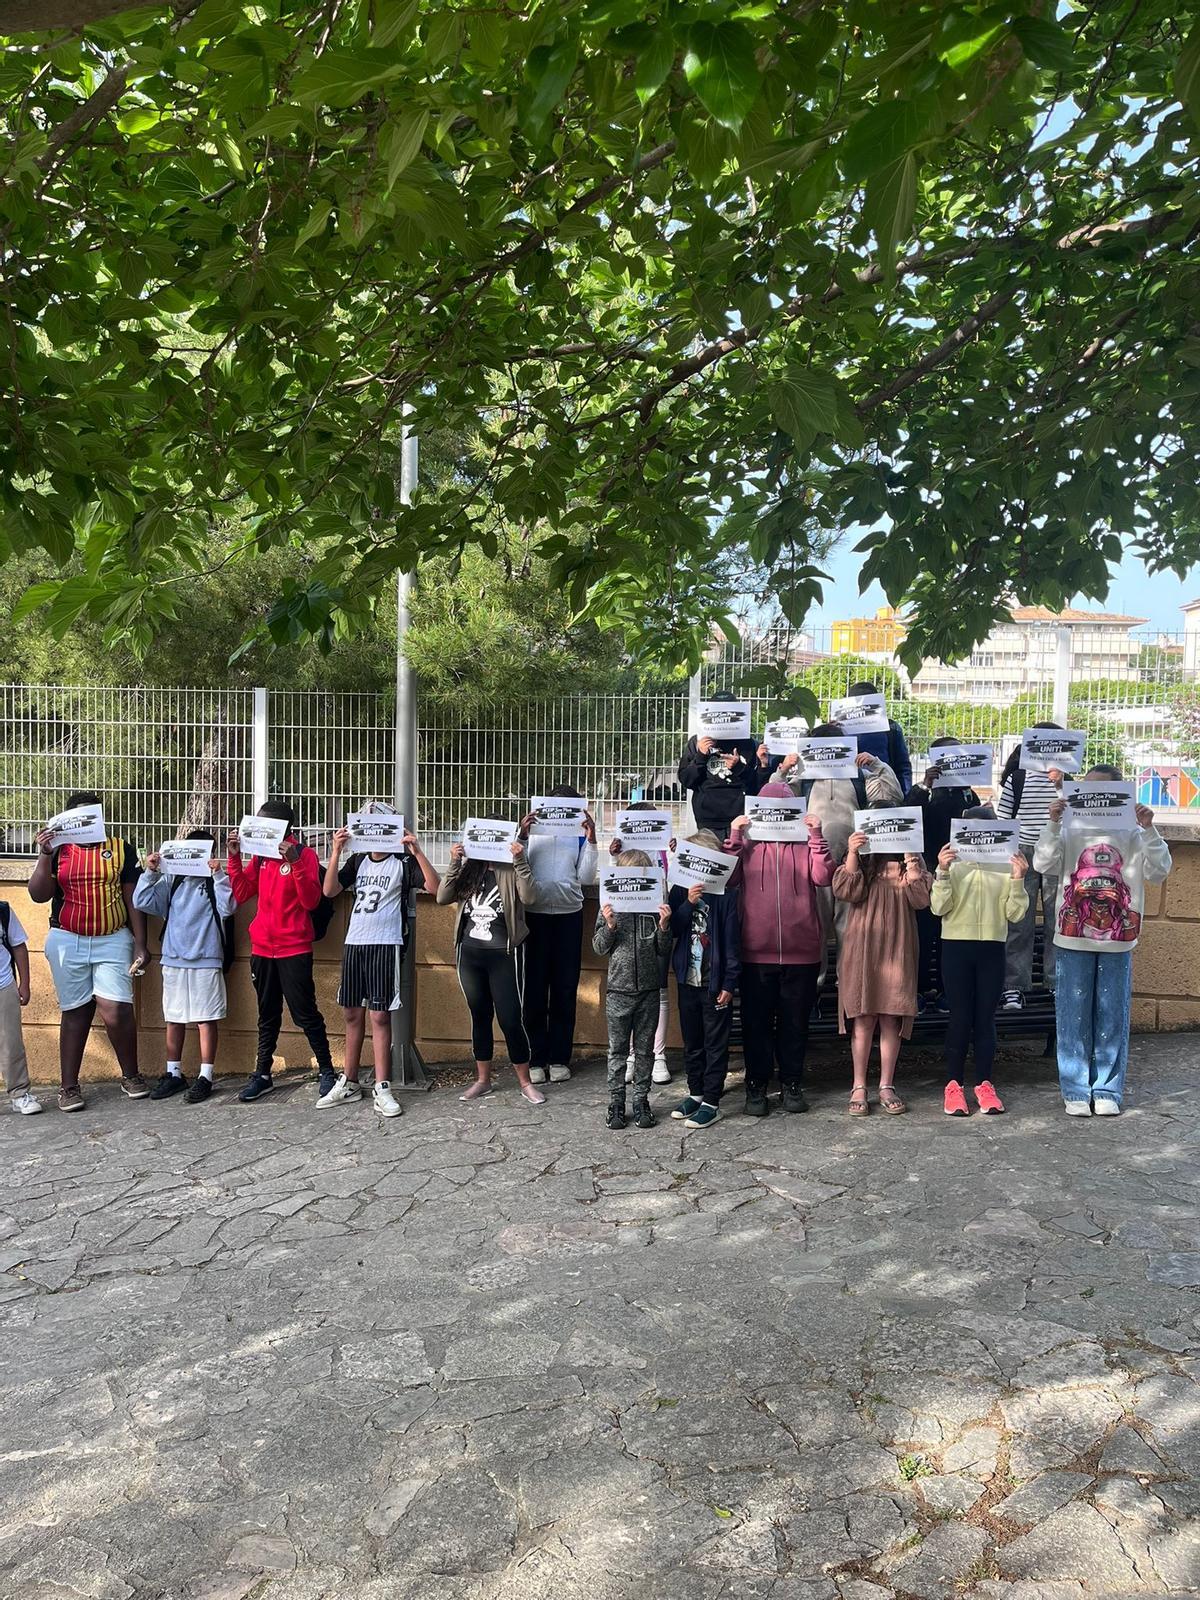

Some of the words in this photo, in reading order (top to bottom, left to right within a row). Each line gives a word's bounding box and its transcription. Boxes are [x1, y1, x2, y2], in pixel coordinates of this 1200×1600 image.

[950, 761, 971, 769] UNIT!
[875, 825, 898, 833] UNIT!
[689, 862, 711, 873] UNIT!
[357, 876, 390, 890] CHICAGO
[354, 891, 381, 913] 23
